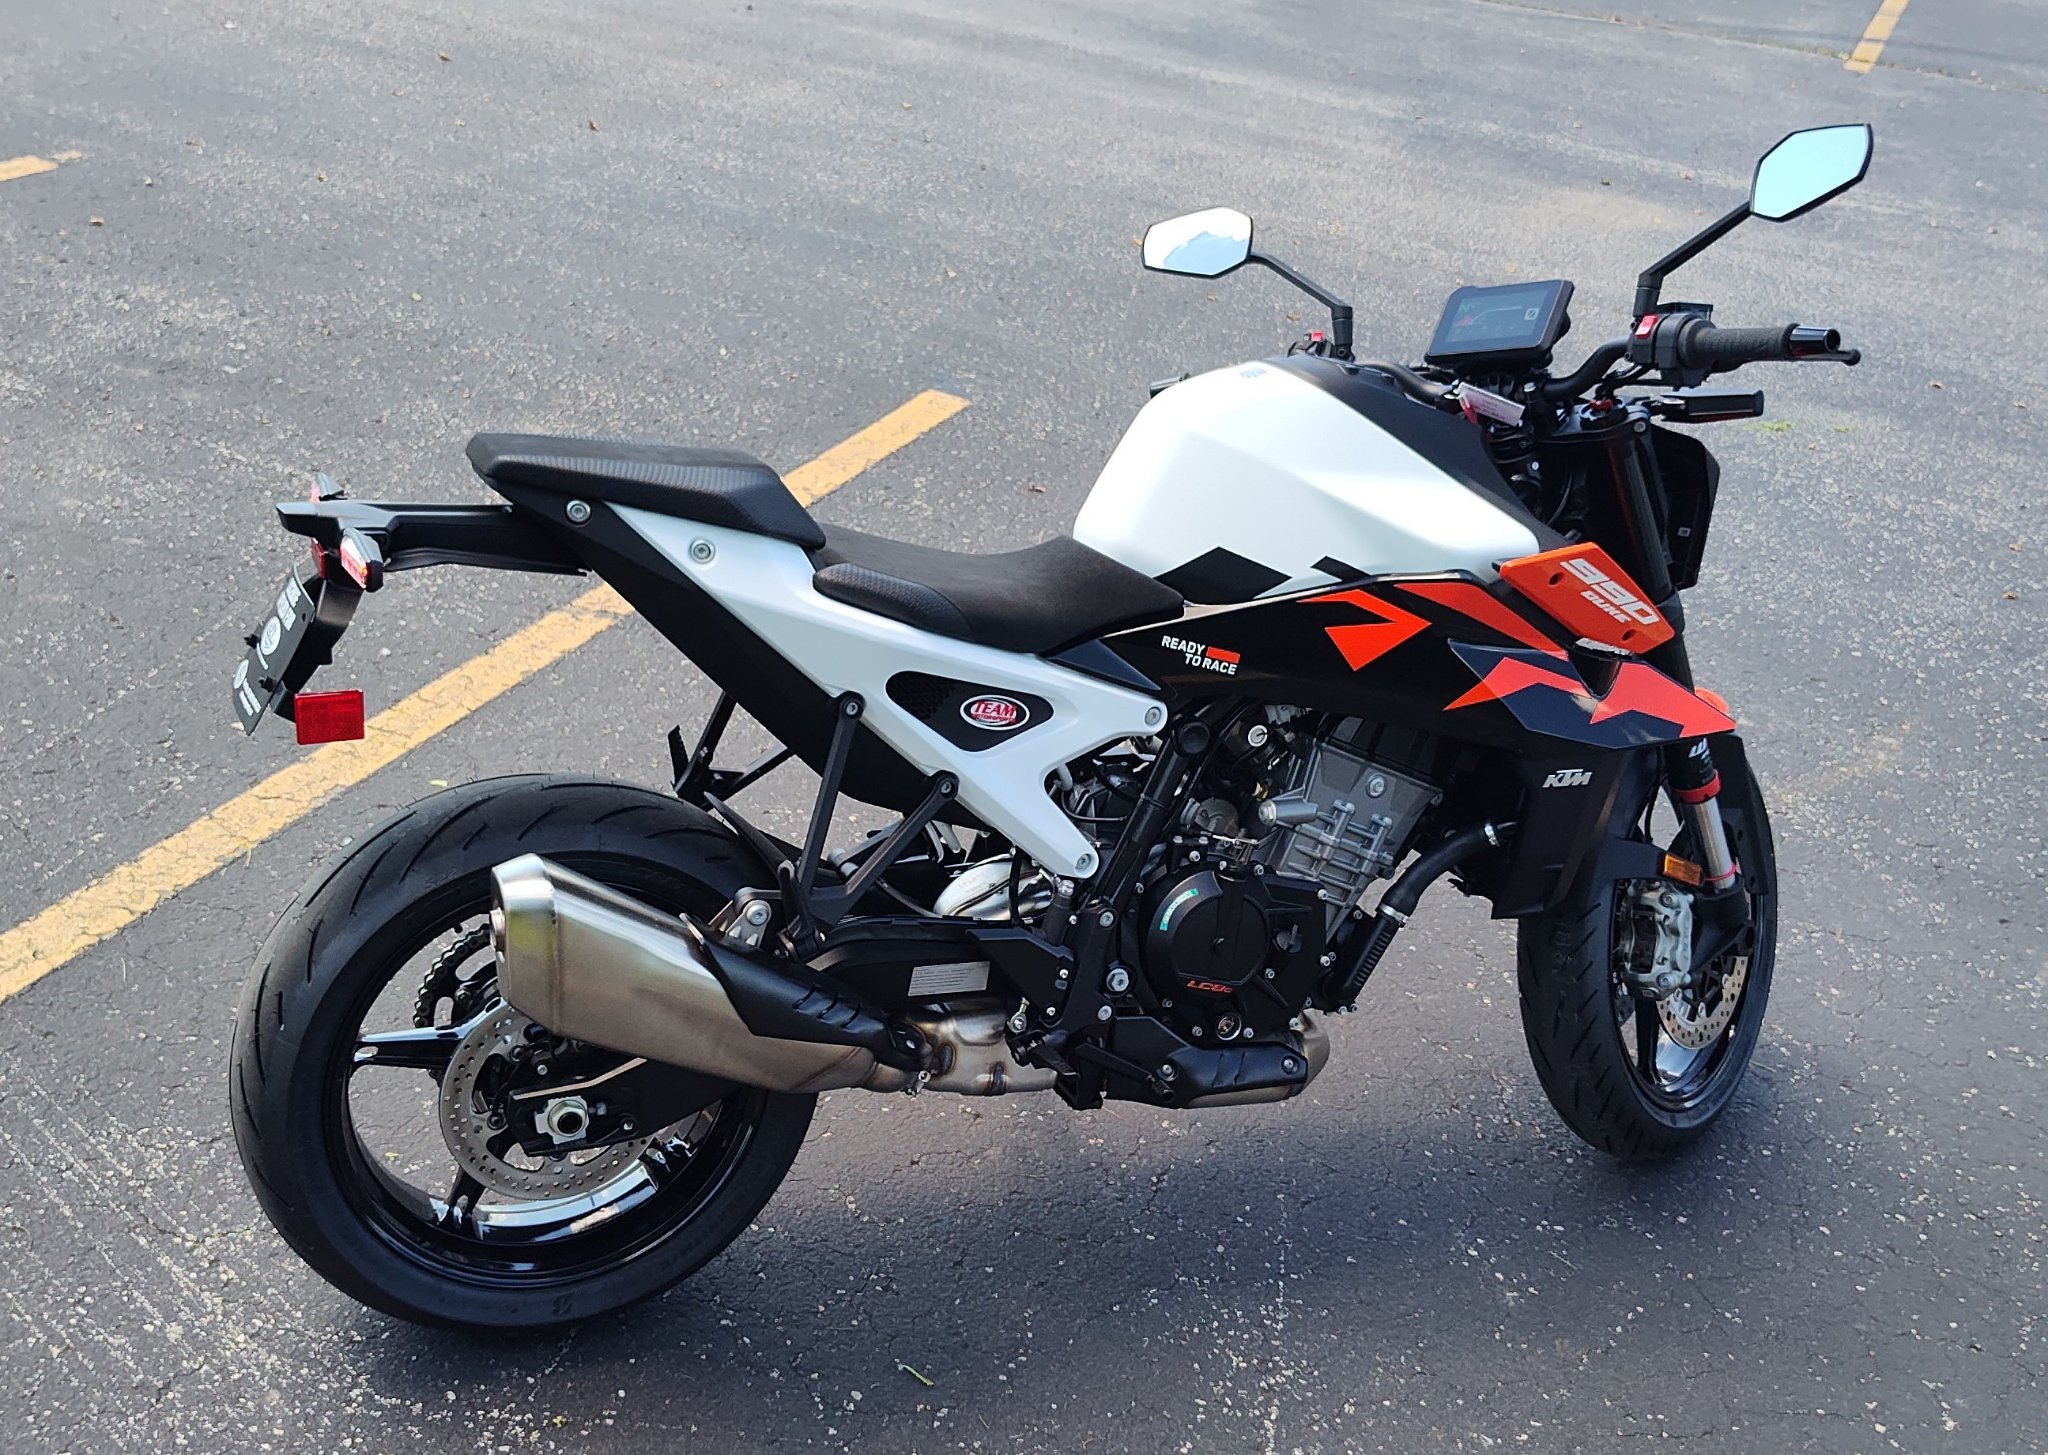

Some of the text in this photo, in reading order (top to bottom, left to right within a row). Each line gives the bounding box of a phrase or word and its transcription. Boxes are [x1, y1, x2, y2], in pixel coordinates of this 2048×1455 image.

[1560, 558, 1660, 625] 990
[1580, 590, 1631, 623] DUKE
[1161, 635, 1206, 655] READY
[1185, 653, 1238, 676] TO RACE
[974, 700, 1017, 717] TEAM
[1542, 768, 1593, 788] KTM
